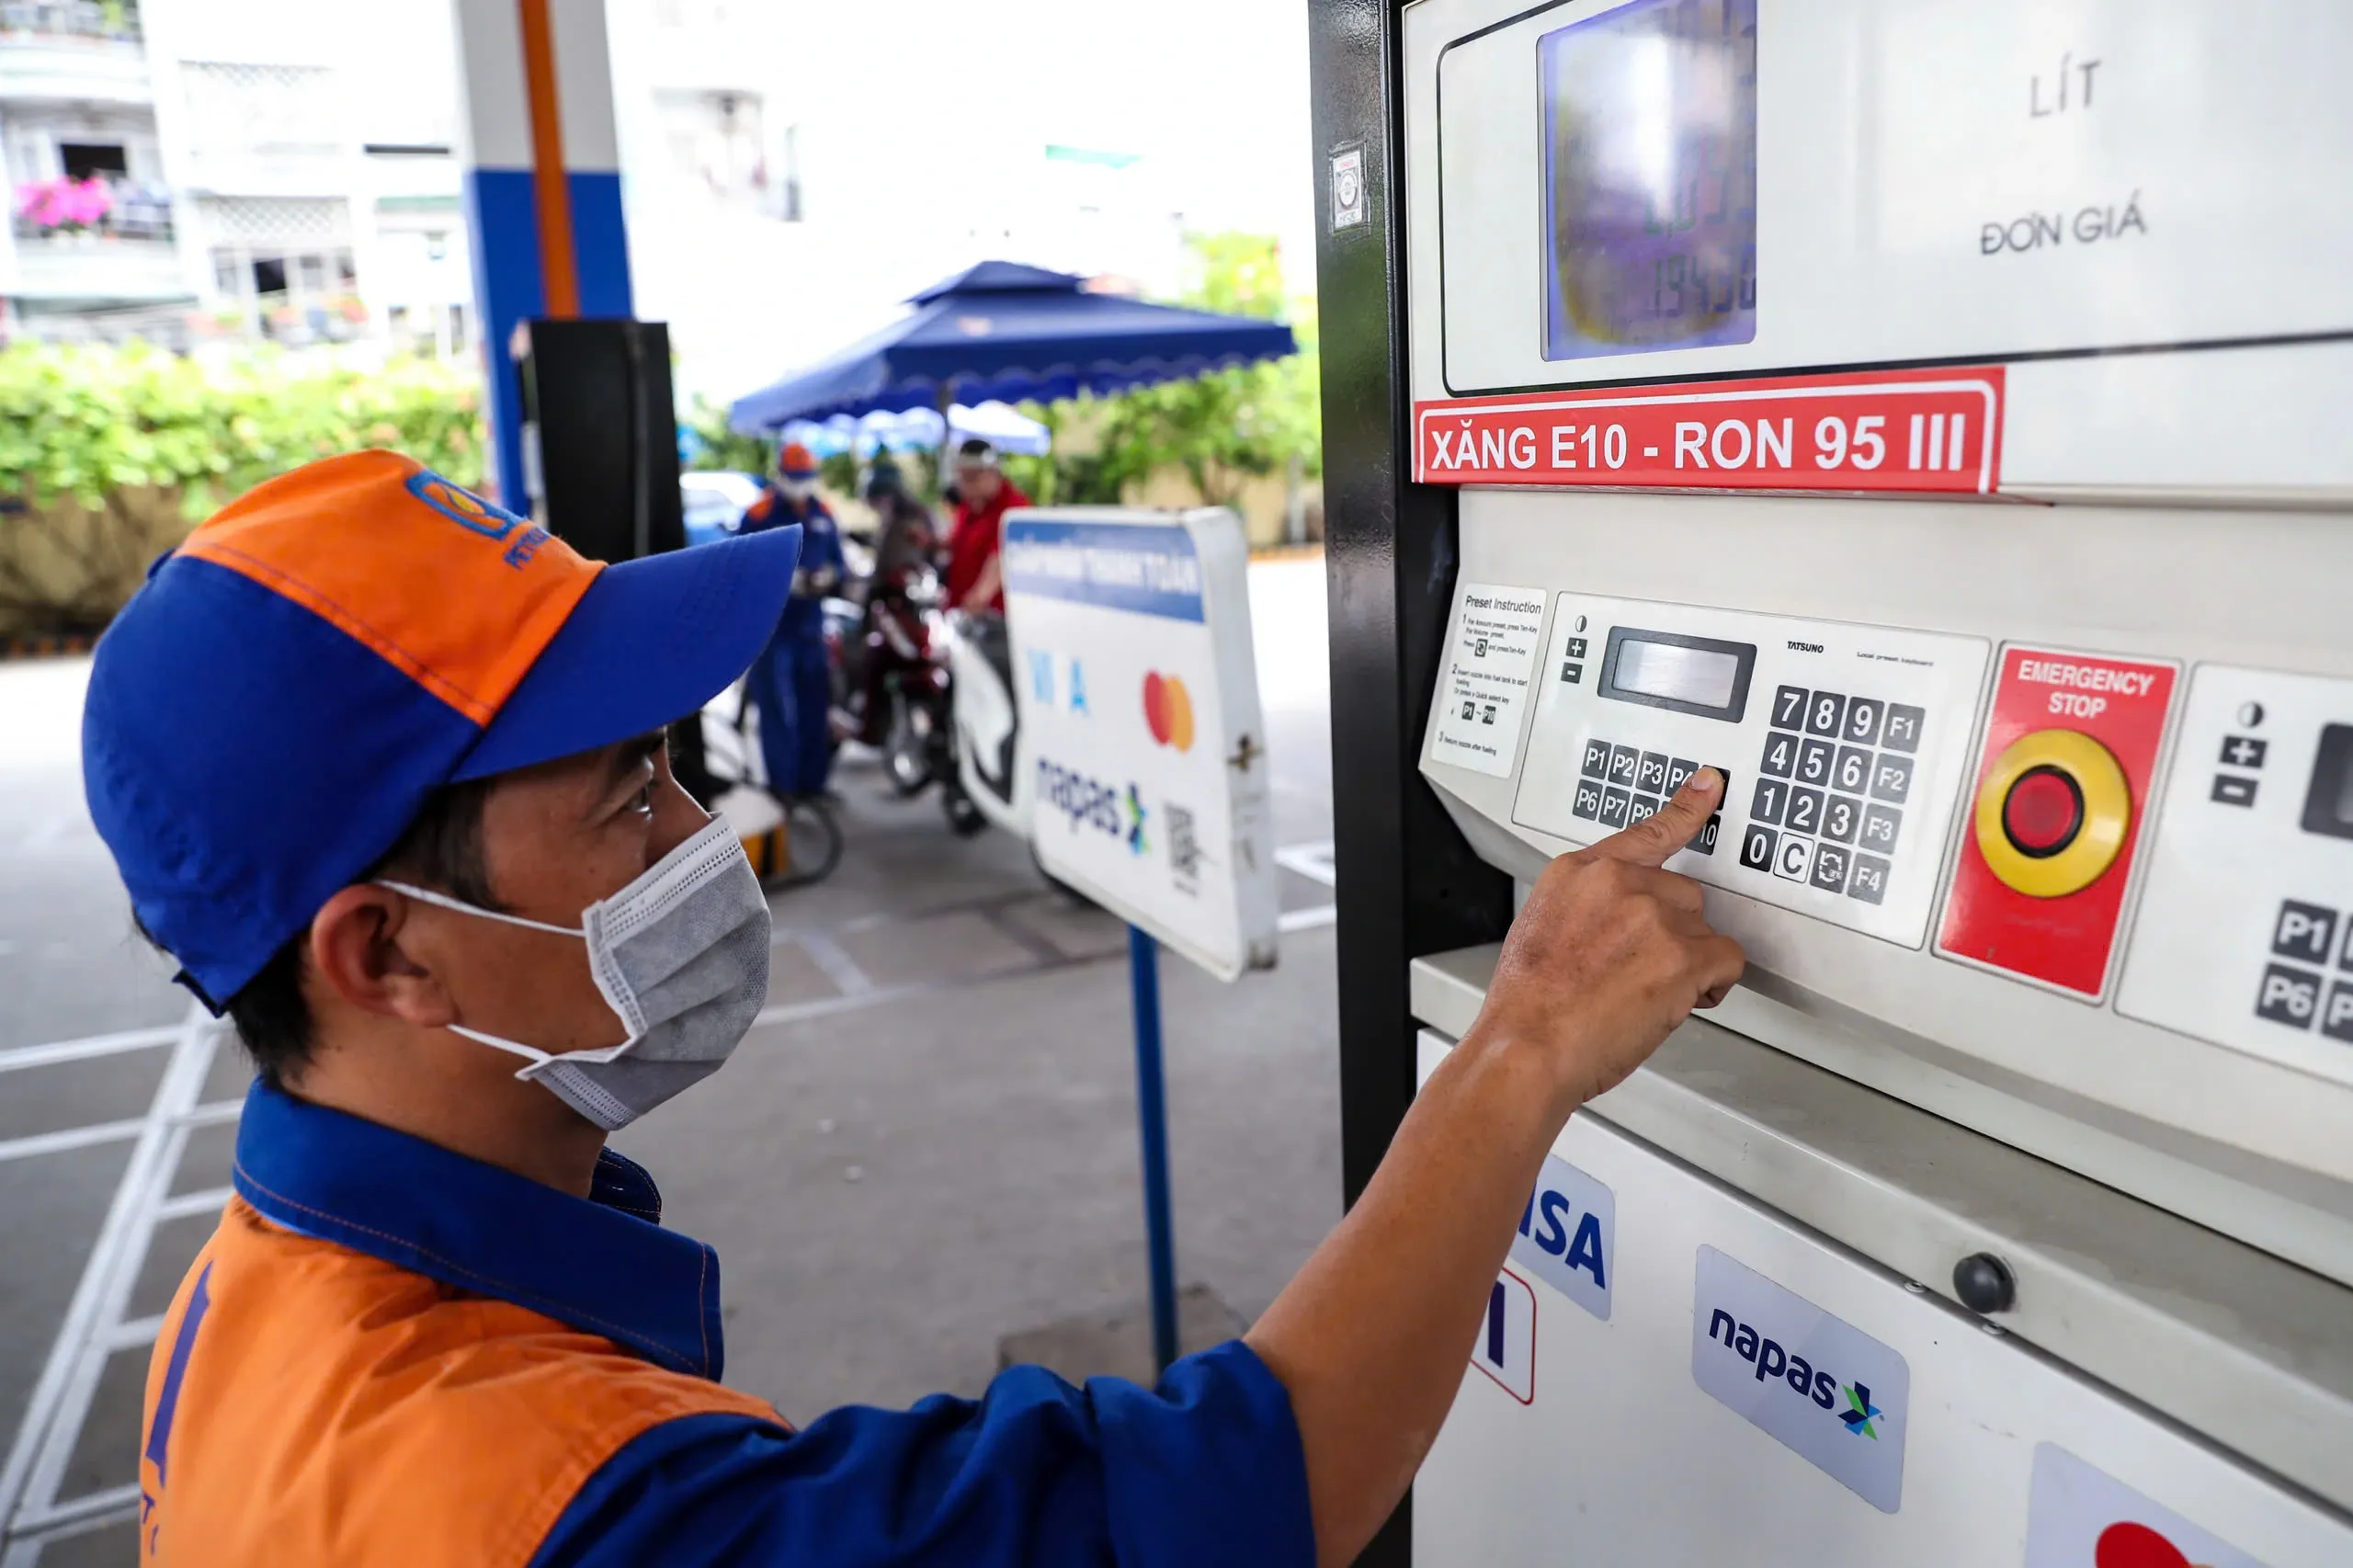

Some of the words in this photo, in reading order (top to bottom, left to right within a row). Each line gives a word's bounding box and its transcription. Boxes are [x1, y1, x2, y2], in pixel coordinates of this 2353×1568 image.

[2029, 51, 2101, 118] LÍT
[1980, 211, 2062, 256] ĐƠN
[2073, 188, 2147, 244] GIÁ
[1431, 418, 1536, 470] XĂNG
[1552, 425, 1627, 470] E10
[1643, 445, 1659, 458] -
[1675, 418, 1792, 470] RON
[1814, 415, 1886, 470] 95
[1909, 414, 1965, 471] III
[1463, 613, 1467, 623] 1
[1466, 596, 1492, 608] Preset
[1494, 598, 1541, 614] Instruction
[1452, 664, 1458, 674] 2
[1787, 642, 1824, 653] TATSUNO
[2018, 659, 2155, 697] EMERGENCY
[1463, 705, 1473, 717] P1
[1483, 709, 1495, 722] P10
[1781, 692, 1801, 722] 7
[1815, 699, 1835, 729] 8
[1853, 705, 1873, 736] 9
[1889, 716, 1914, 740] F1
[2048, 691, 2107, 719] STOP
[1586, 747, 1606, 770] P1
[1612, 754, 1634, 778] P2
[1641, 760, 1663, 785] P3
[1770, 741, 1788, 770] 4
[1804, 747, 1824, 778] 5
[1842, 756, 1862, 787] 6
[1878, 767, 1904, 790] F2
[1576, 788, 1597, 812] P6
[1603, 796, 1626, 819] P7
[1631, 802, 1654, 824] P8
[1763, 787, 1775, 816] 1
[1793, 795, 1813, 826] 2
[1831, 804, 1851, 835] 3
[1867, 816, 1893, 841] F3
[1749, 834, 1768, 864] 0
[1783, 843, 1805, 874] C
[1856, 867, 1881, 892] F4
[2278, 911, 2327, 953] P1
[2262, 974, 2315, 1018] P6
[2328, 992, 2353, 1028] P
[1518, 1181, 1606, 1290] ISA
[1710, 1308, 1836, 1411] napas
